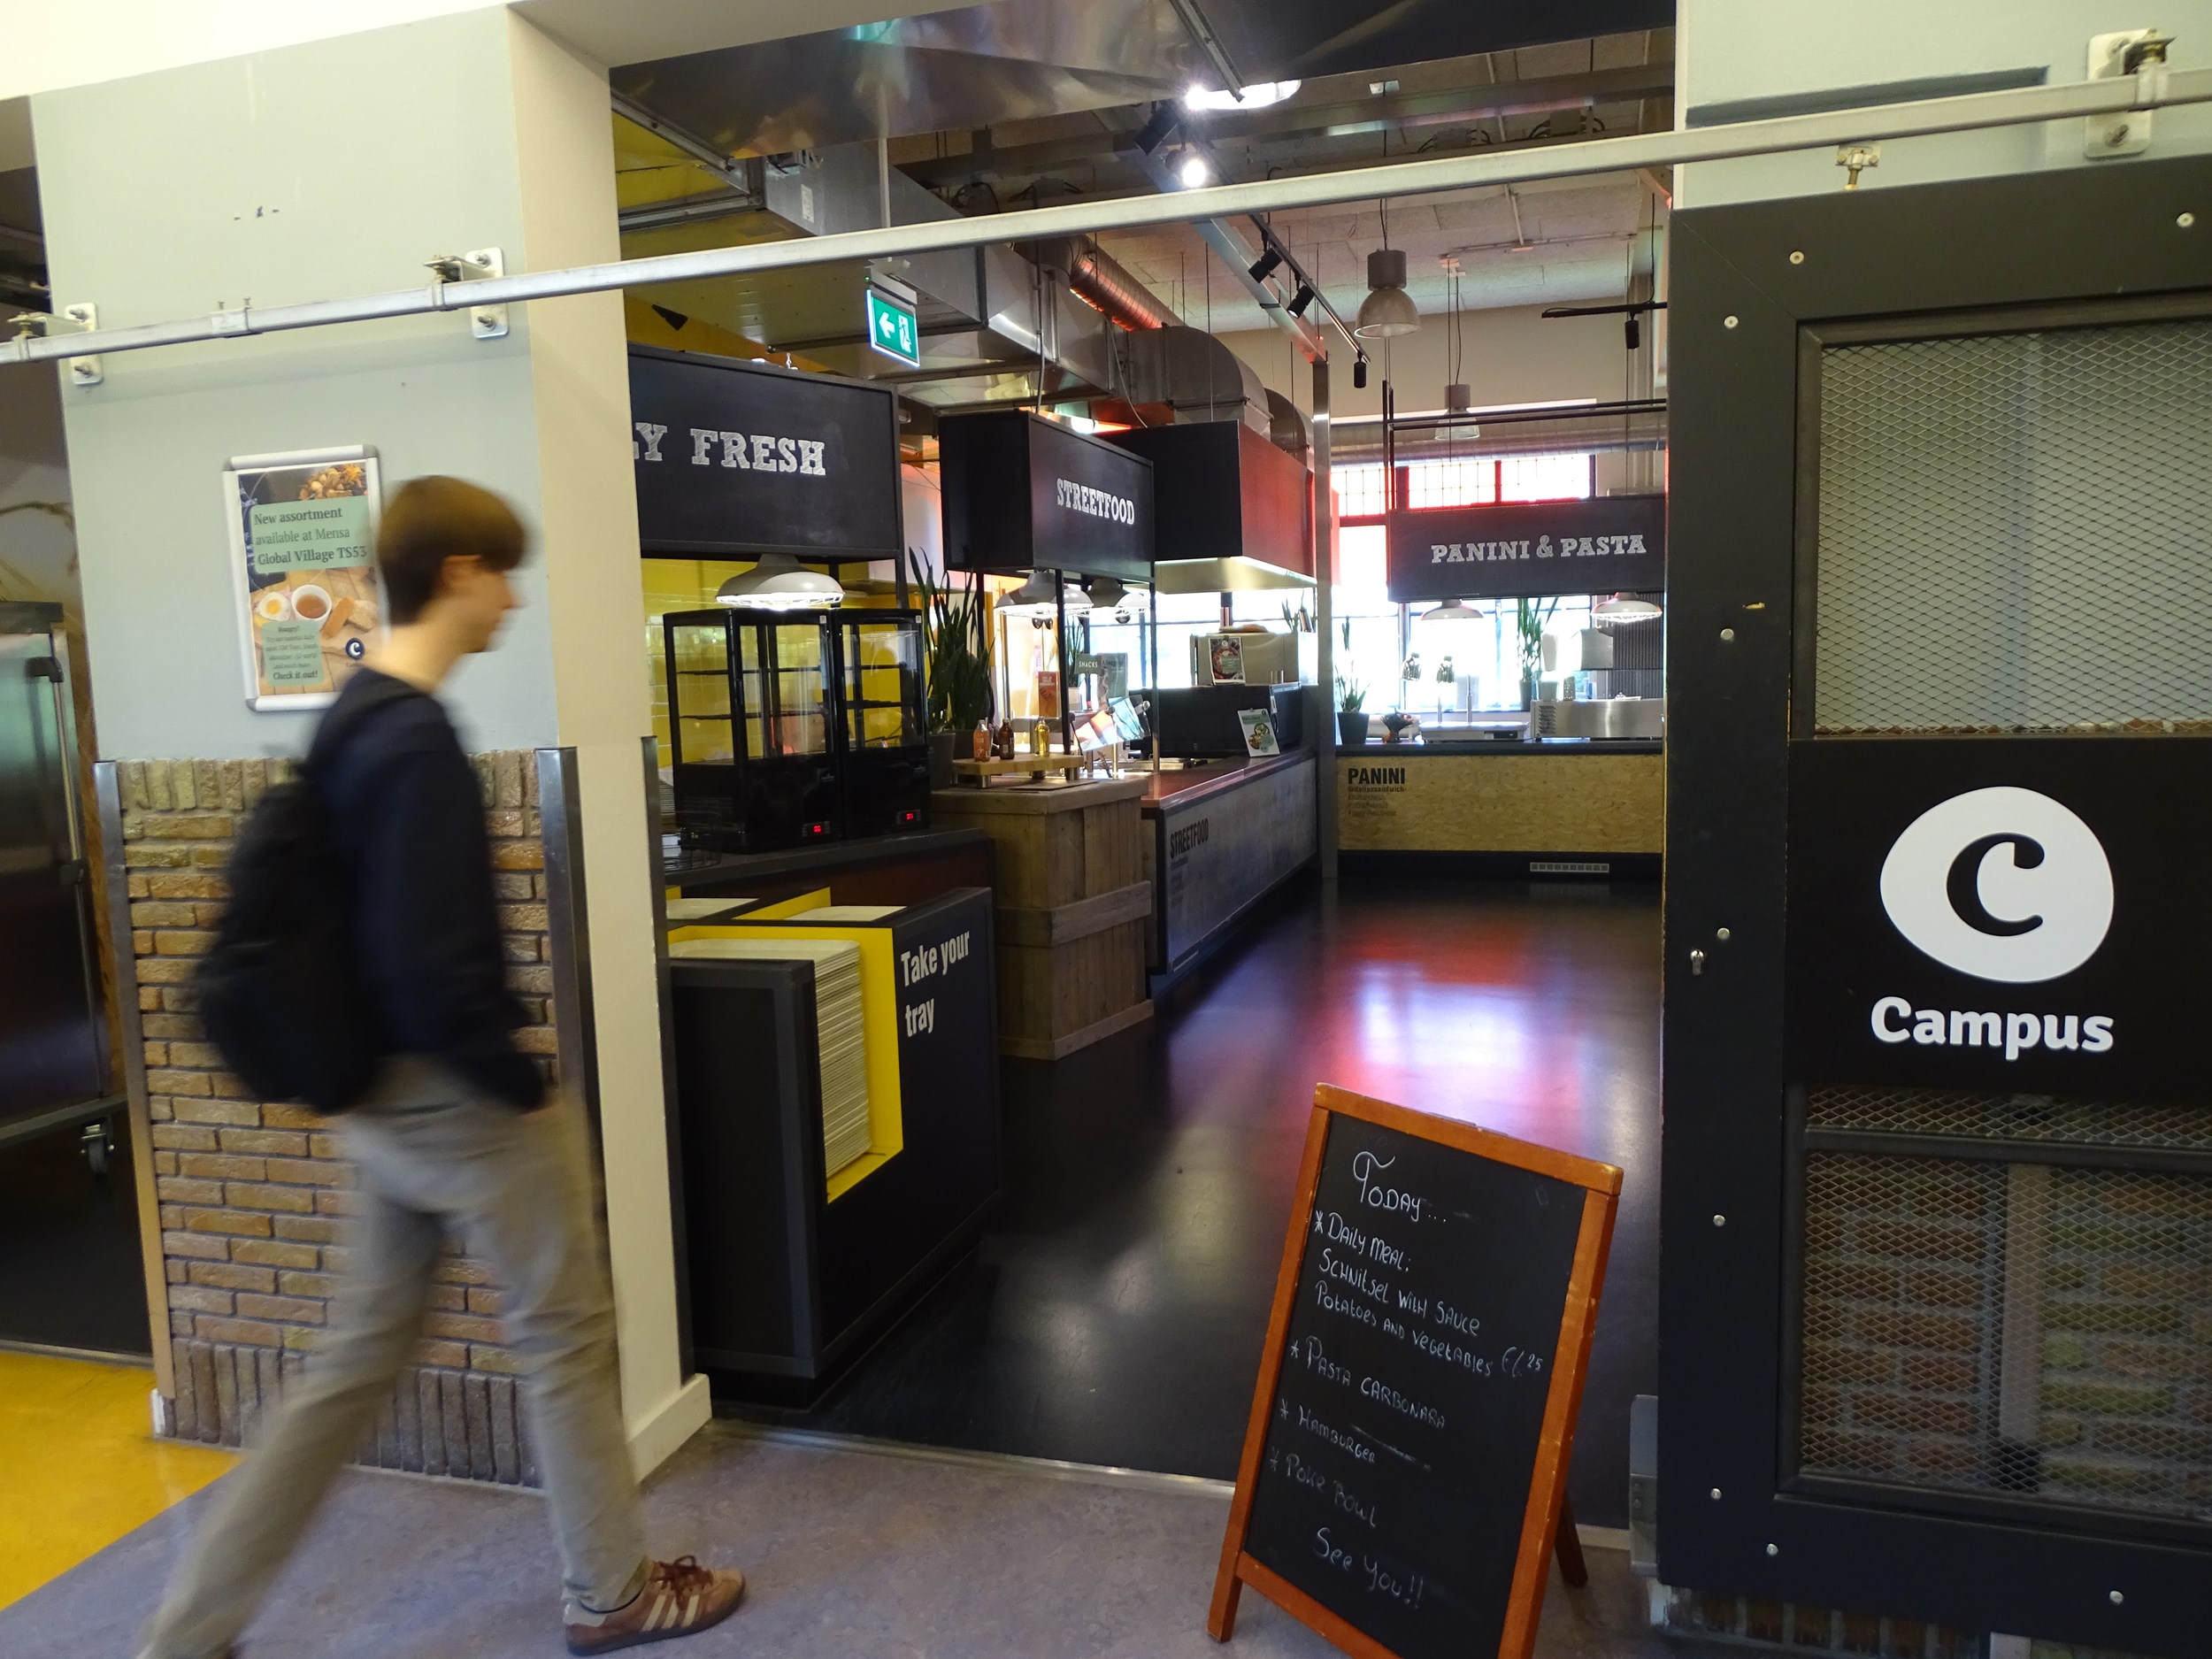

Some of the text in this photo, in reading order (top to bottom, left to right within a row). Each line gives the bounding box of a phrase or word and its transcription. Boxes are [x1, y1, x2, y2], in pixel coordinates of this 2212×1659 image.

[633, 422, 826, 476] Y FRESH
[254, 508, 343, 525] New assortment
[1056, 478, 1135, 526] STREETFOOD
[256, 528, 350, 545] available at Mensa
[1431, 534, 1647, 564] PANINI & PASTA
[258, 551, 291, 565] Global
[294, 549, 334, 563] Village
[1348, 767, 1405, 785] PANINI
[1170, 818, 1210, 859] STREETFOOD
[901, 931, 970, 987] Take your
[905, 998, 934, 1037] tray
[1870, 996, 2114, 1061] Campus
